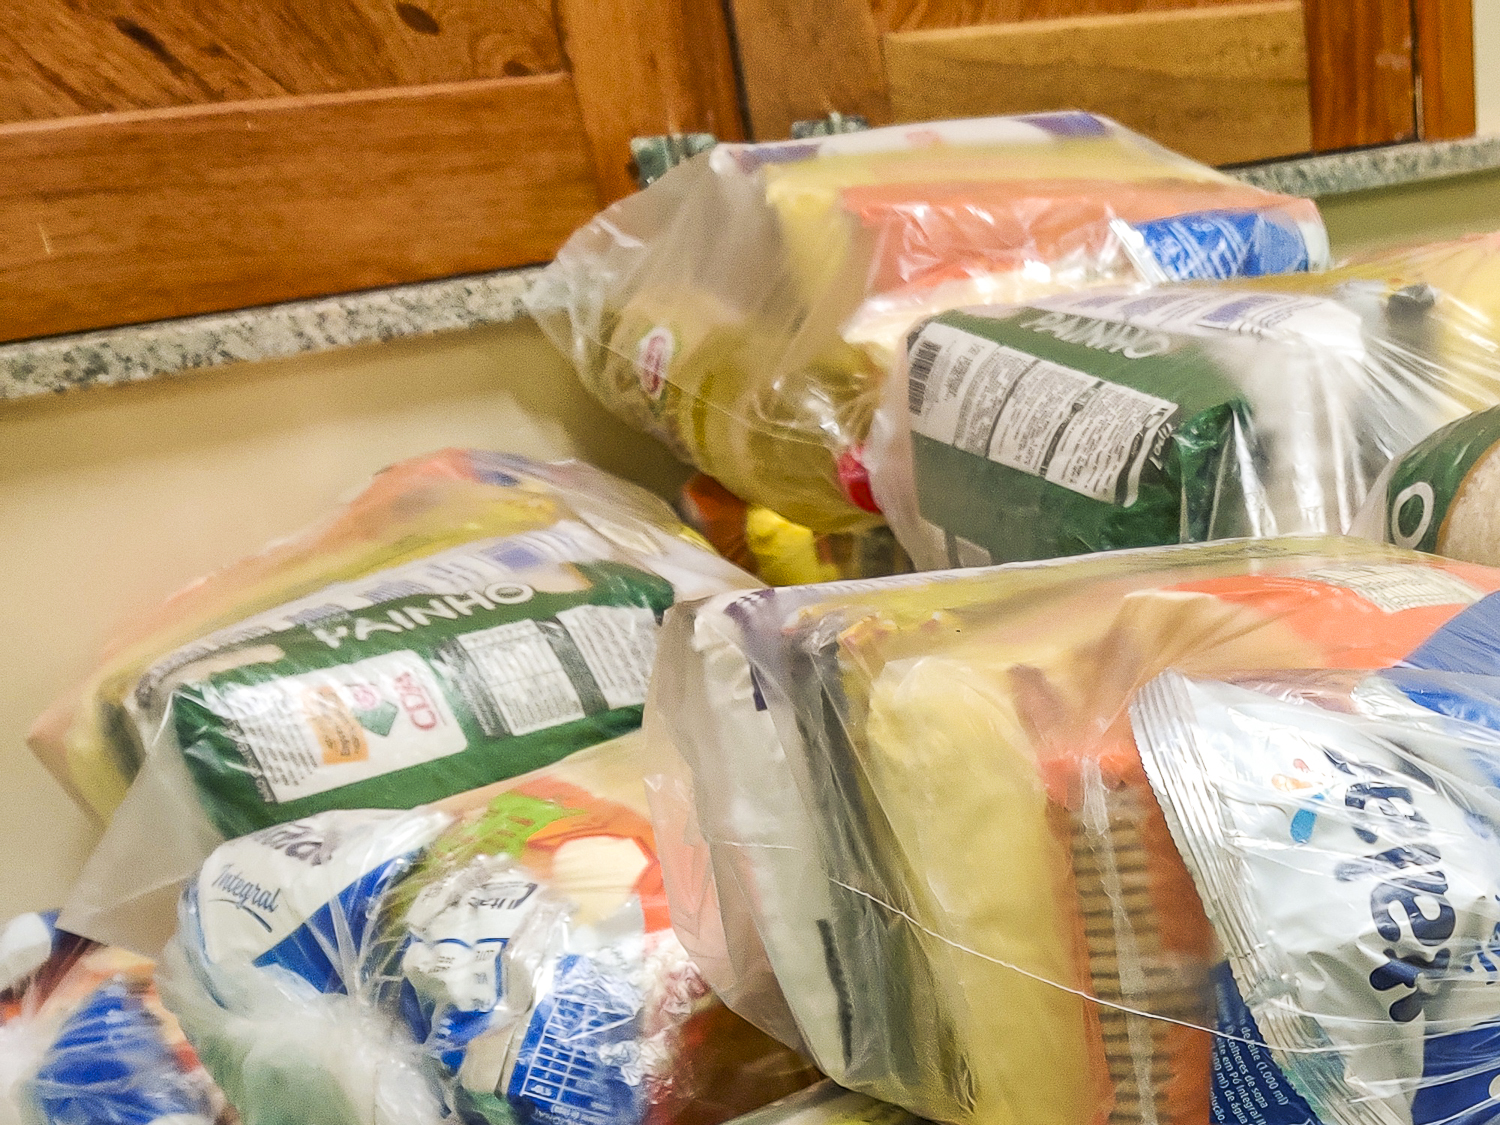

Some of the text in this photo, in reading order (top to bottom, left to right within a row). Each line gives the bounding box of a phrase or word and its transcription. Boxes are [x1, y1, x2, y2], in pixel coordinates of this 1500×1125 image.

[211, 862, 282, 915] Integral
[1220, 1055, 1234, 1072] em
[1226, 1037, 1250, 1075] colheres
[1228, 1069, 1243, 1085] Pó
[1244, 1073, 1257, 1087] de
[1255, 1060, 1278, 1091] (1.000
[1272, 1088, 1289, 1107] ml)
[1214, 1070, 1231, 1089] ml)
[1223, 1087, 1237, 1102] de
[1231, 1100, 1249, 1125] água
[1234, 1083, 1261, 1121] Integral
[1249, 1085, 1268, 1110] sopa
